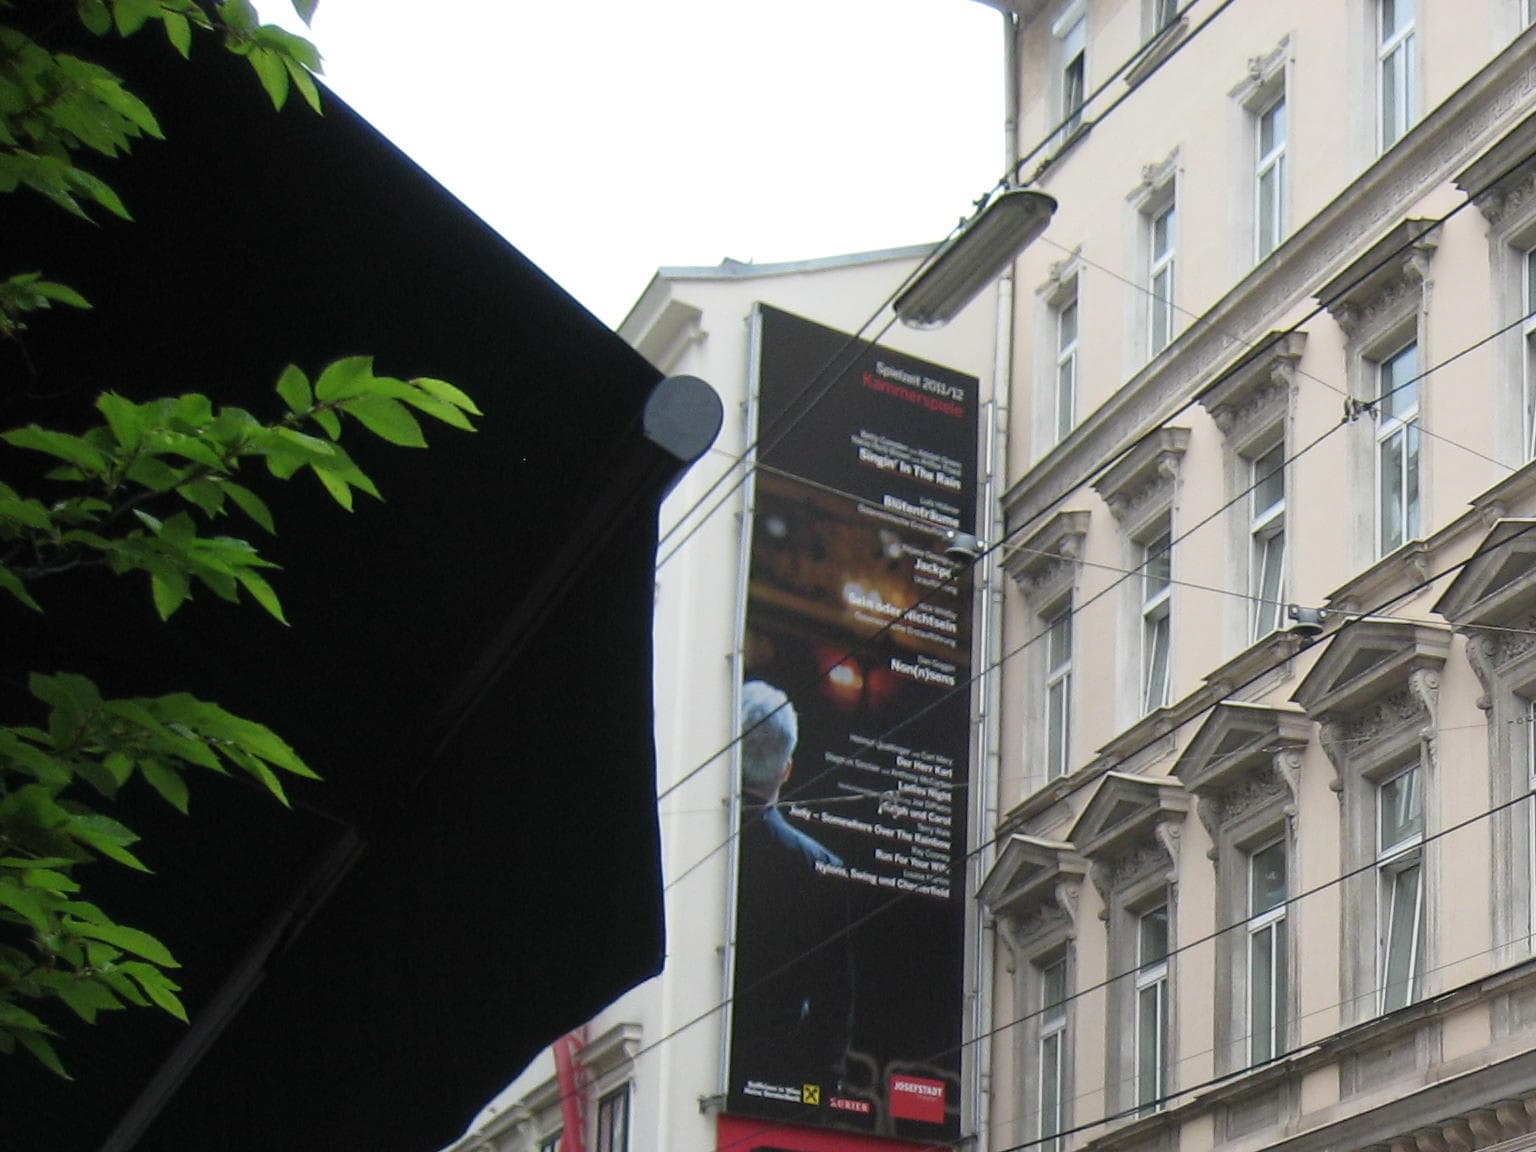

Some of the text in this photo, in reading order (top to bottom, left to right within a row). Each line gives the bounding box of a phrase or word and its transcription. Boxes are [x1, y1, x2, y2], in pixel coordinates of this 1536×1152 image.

[914, 463, 934, 482] The
[891, 658, 955, 686] Non(n)sens
[894, 1082, 944, 1098] JOSEFSTADT
